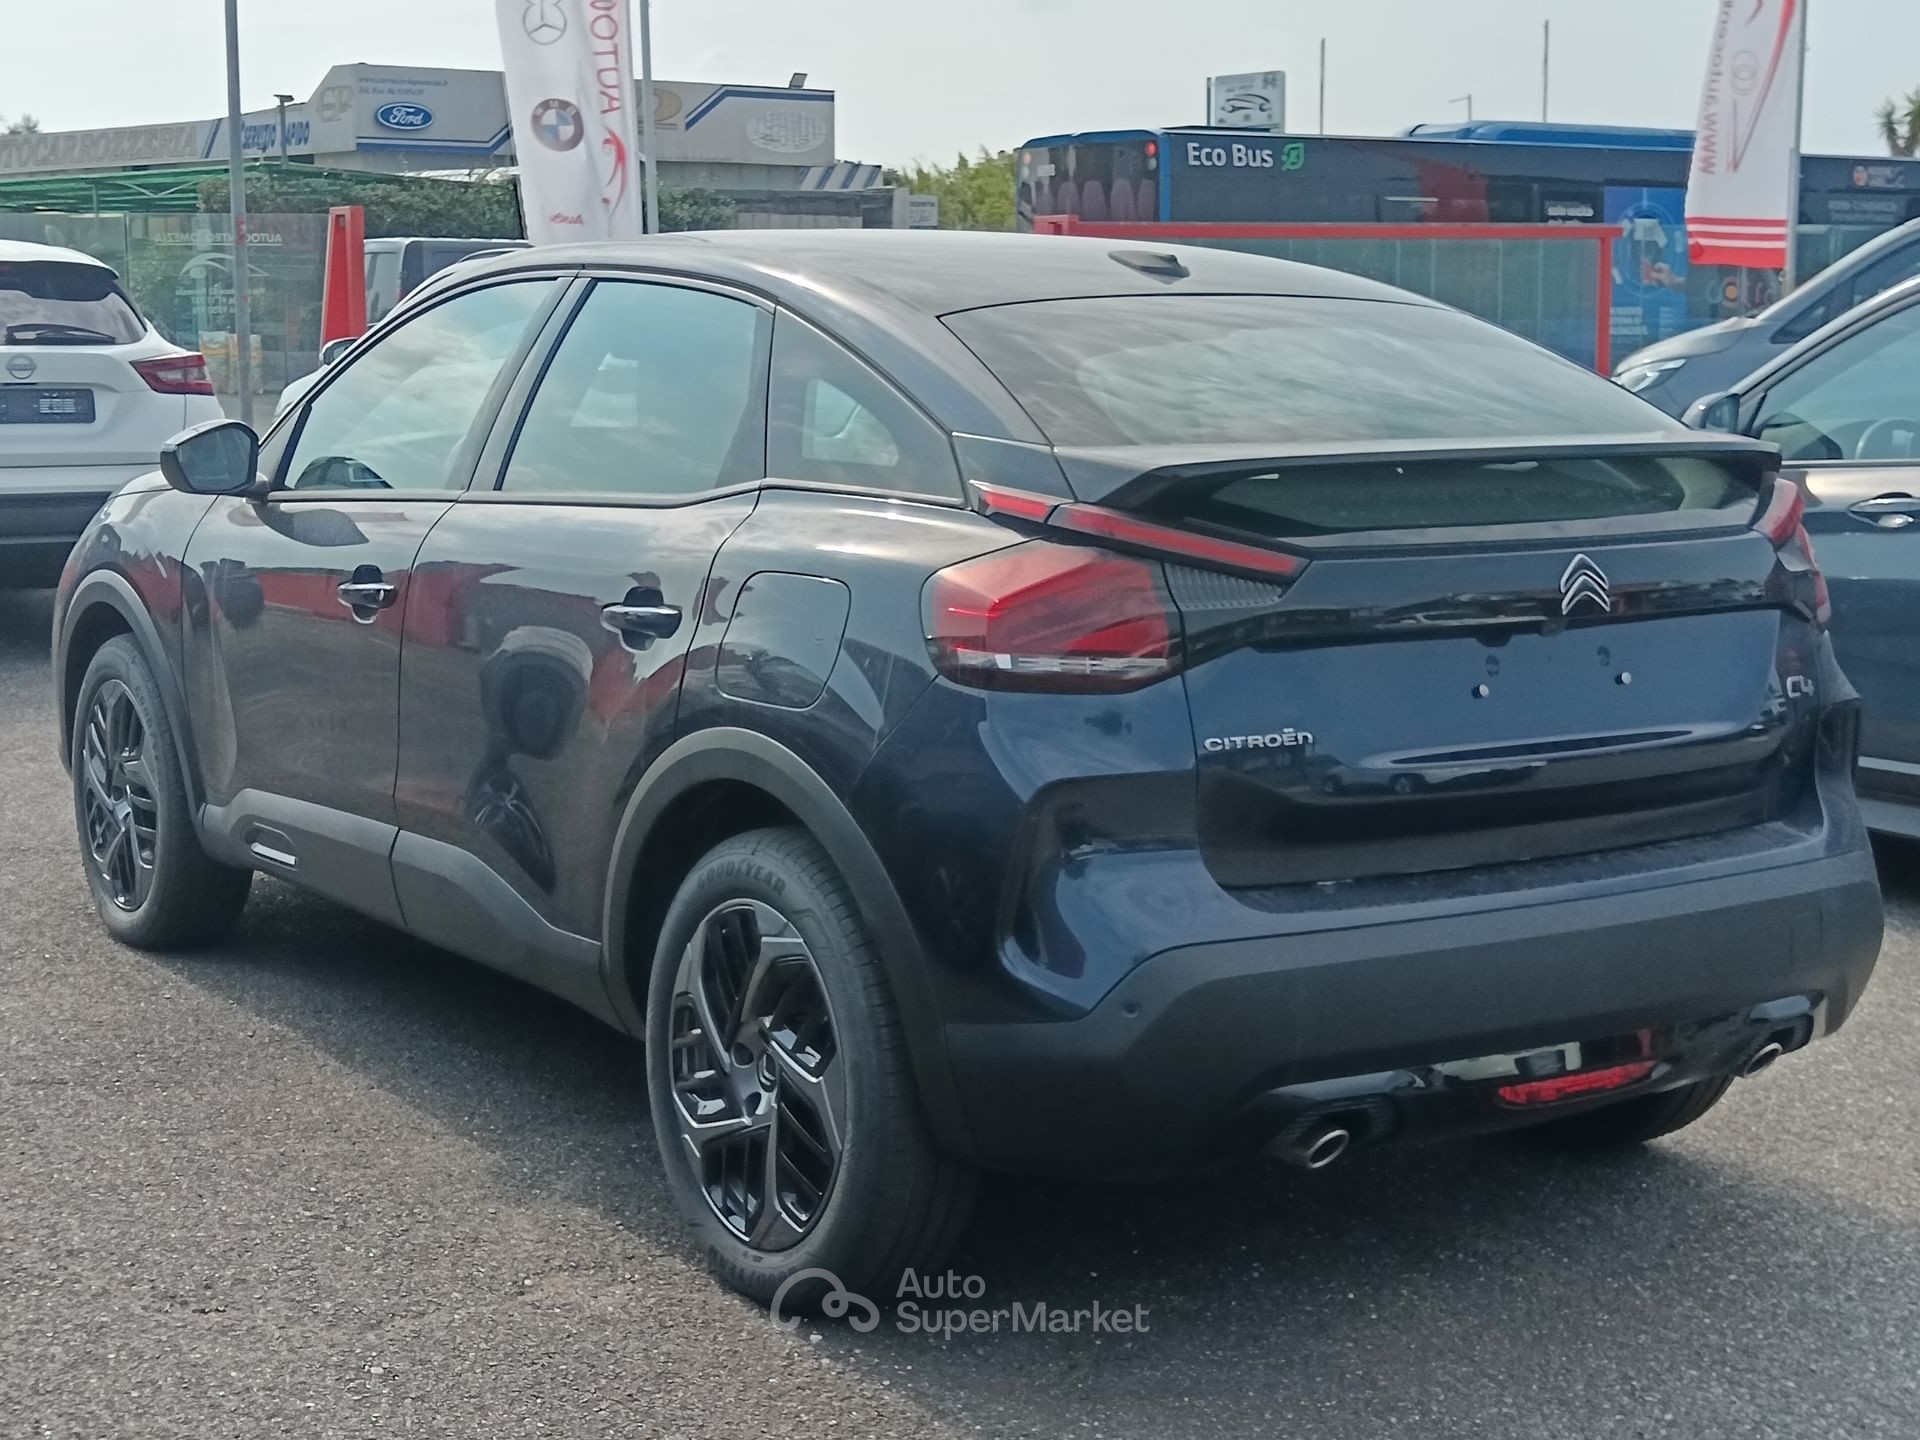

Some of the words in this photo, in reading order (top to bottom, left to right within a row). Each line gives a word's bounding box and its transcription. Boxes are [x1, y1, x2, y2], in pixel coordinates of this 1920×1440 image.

[390, 106, 424, 125] Ford
[1186, 142, 1227, 166] Eco
[1232, 143, 1274, 168] Bus
[1786, 675, 1814, 698] C4
